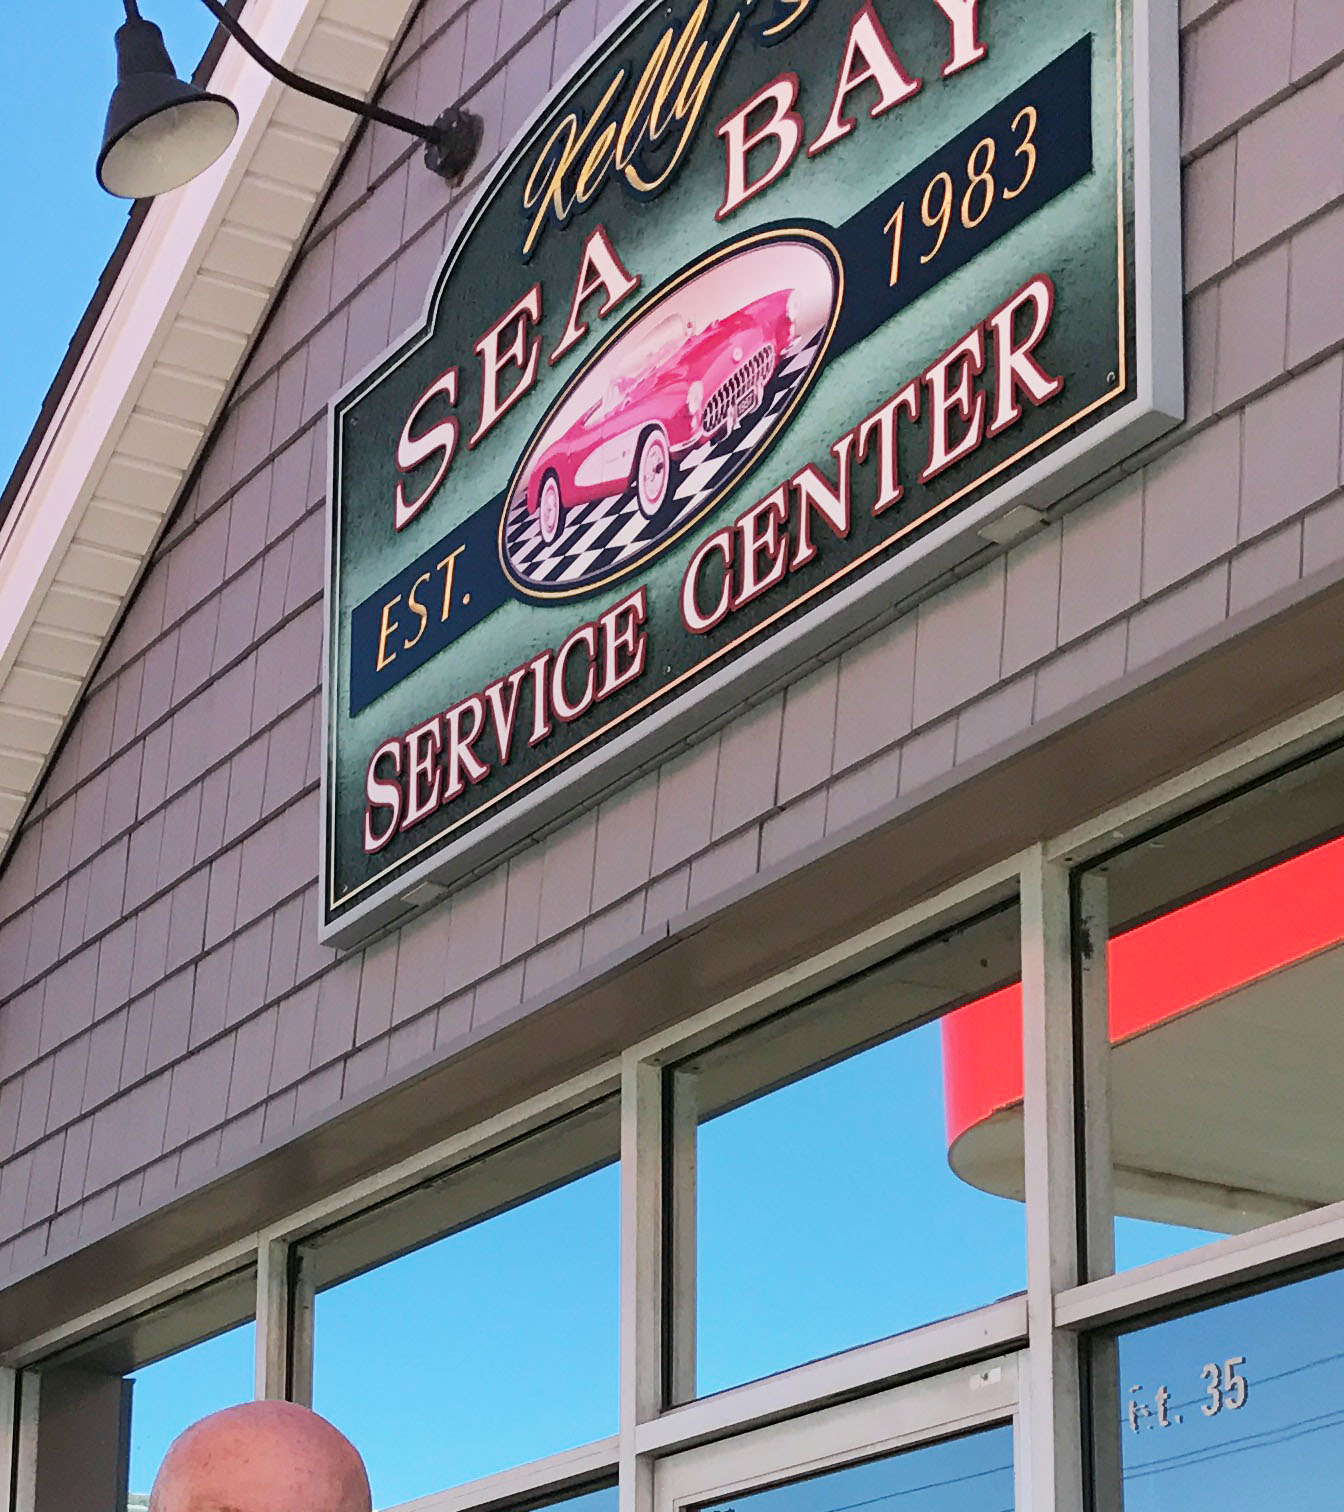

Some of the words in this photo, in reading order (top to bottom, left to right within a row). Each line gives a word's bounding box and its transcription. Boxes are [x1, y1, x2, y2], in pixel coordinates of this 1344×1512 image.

[376, 546, 471, 672] EST.
[884, 106, 1038, 287] 1983
[394, 225, 641, 533] SEA
[714, 0, 987, 223] BAY
[363, 588, 647, 854] SERVICE
[681, 273, 1063, 635] CENTER
[1201, 1356, 1248, 1416] 35
